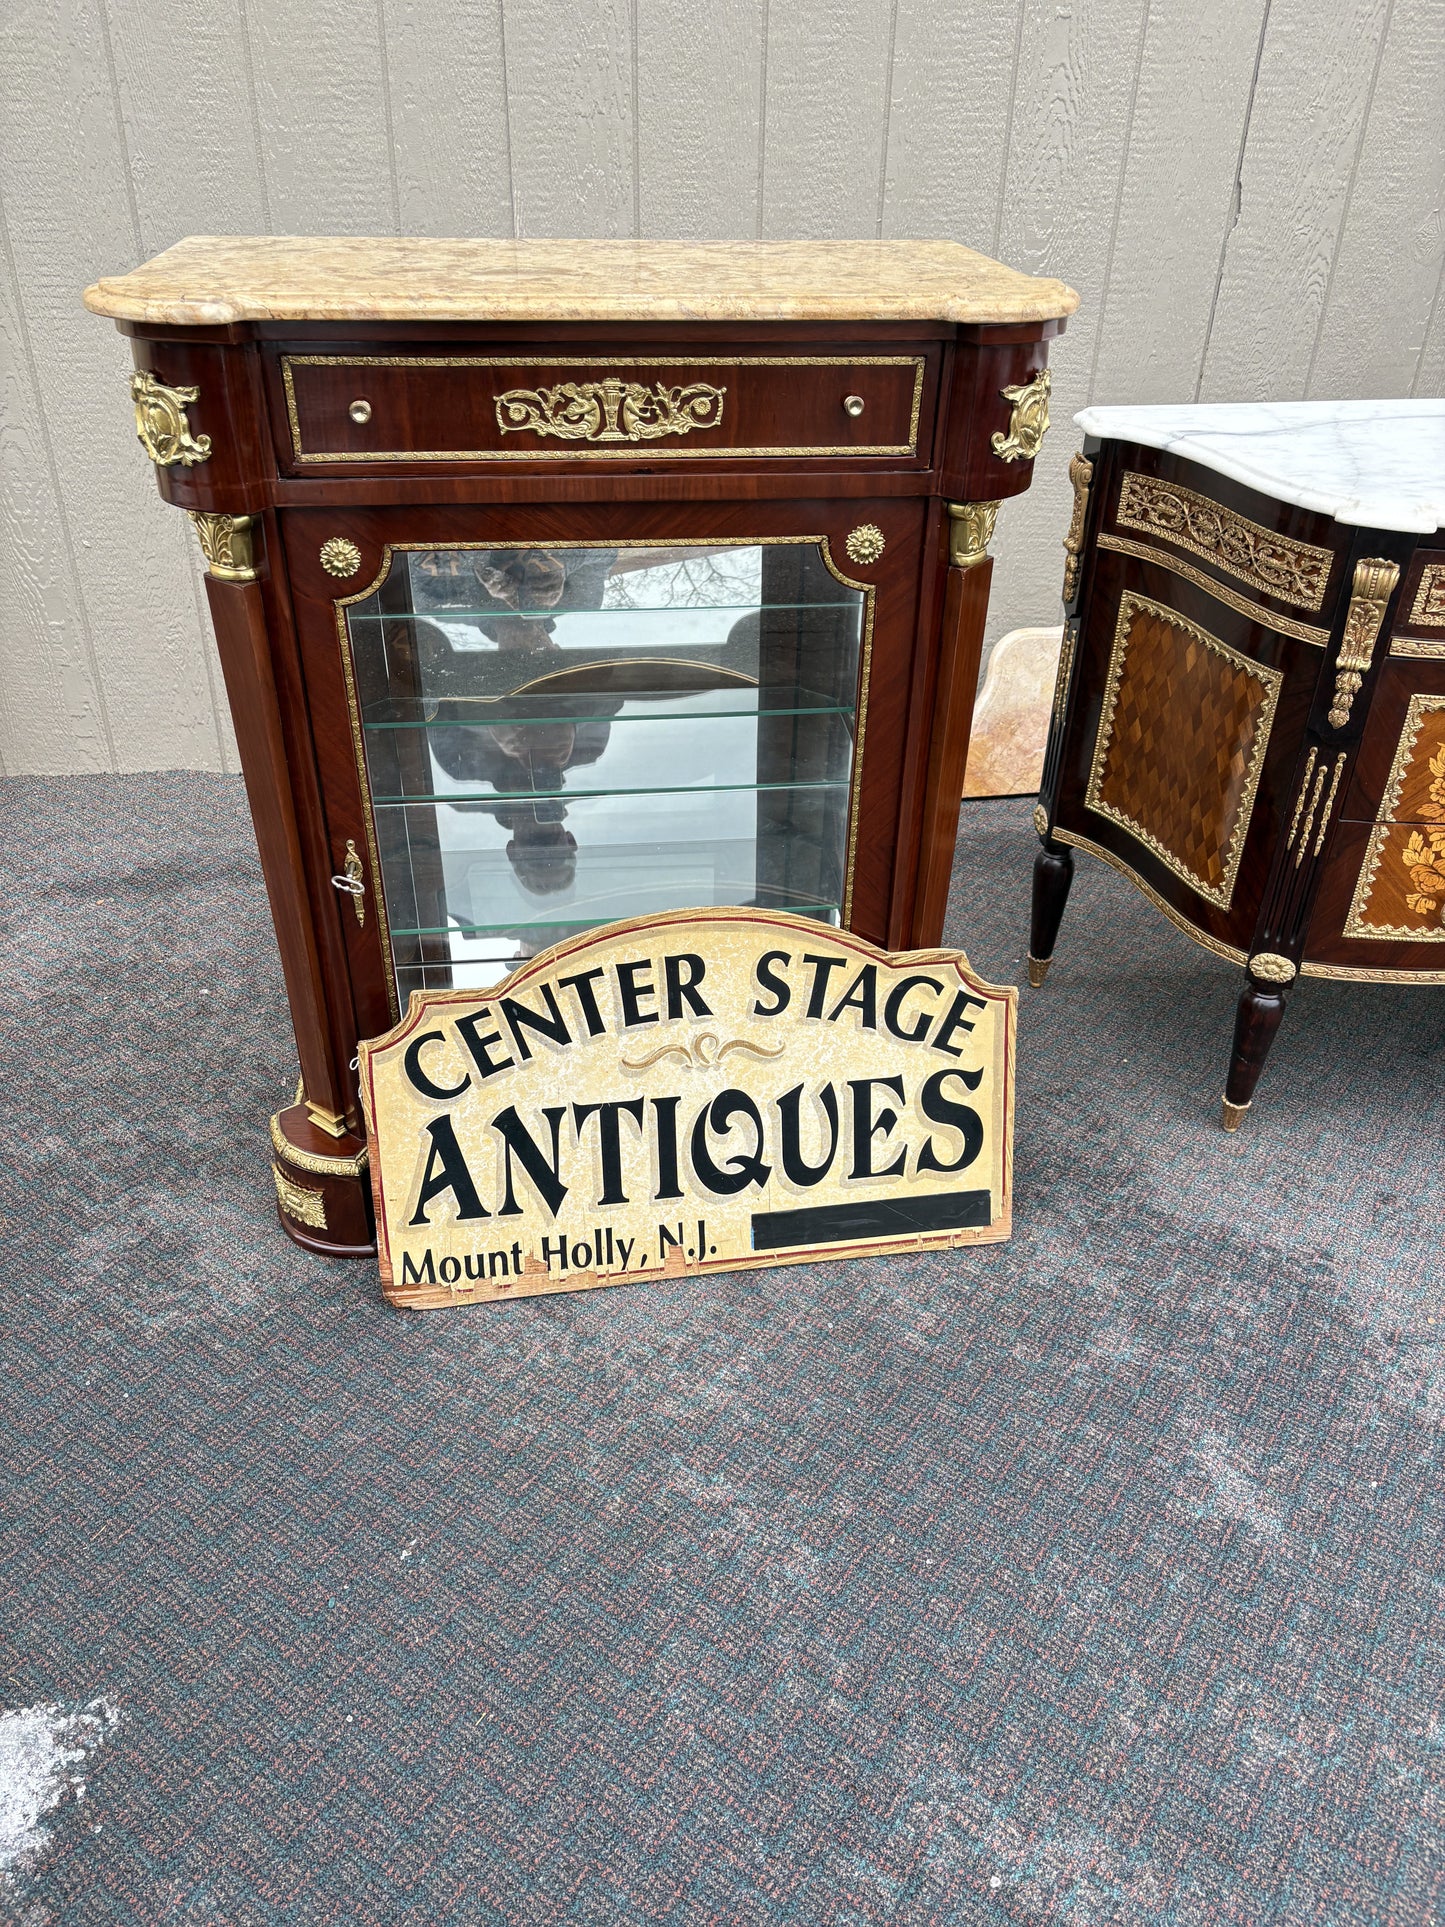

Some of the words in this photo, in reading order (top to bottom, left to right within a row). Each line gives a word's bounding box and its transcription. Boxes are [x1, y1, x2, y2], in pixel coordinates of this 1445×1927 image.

[404, 952, 714, 1101] CENTER
[754, 950, 989, 1058] STAGE
[408, 1067, 985, 1226] ANTIQUES
[402, 1241, 525, 1287] Mount
[541, 1227, 648, 1273] Holly,
[658, 1219, 717, 1262] N.J.
